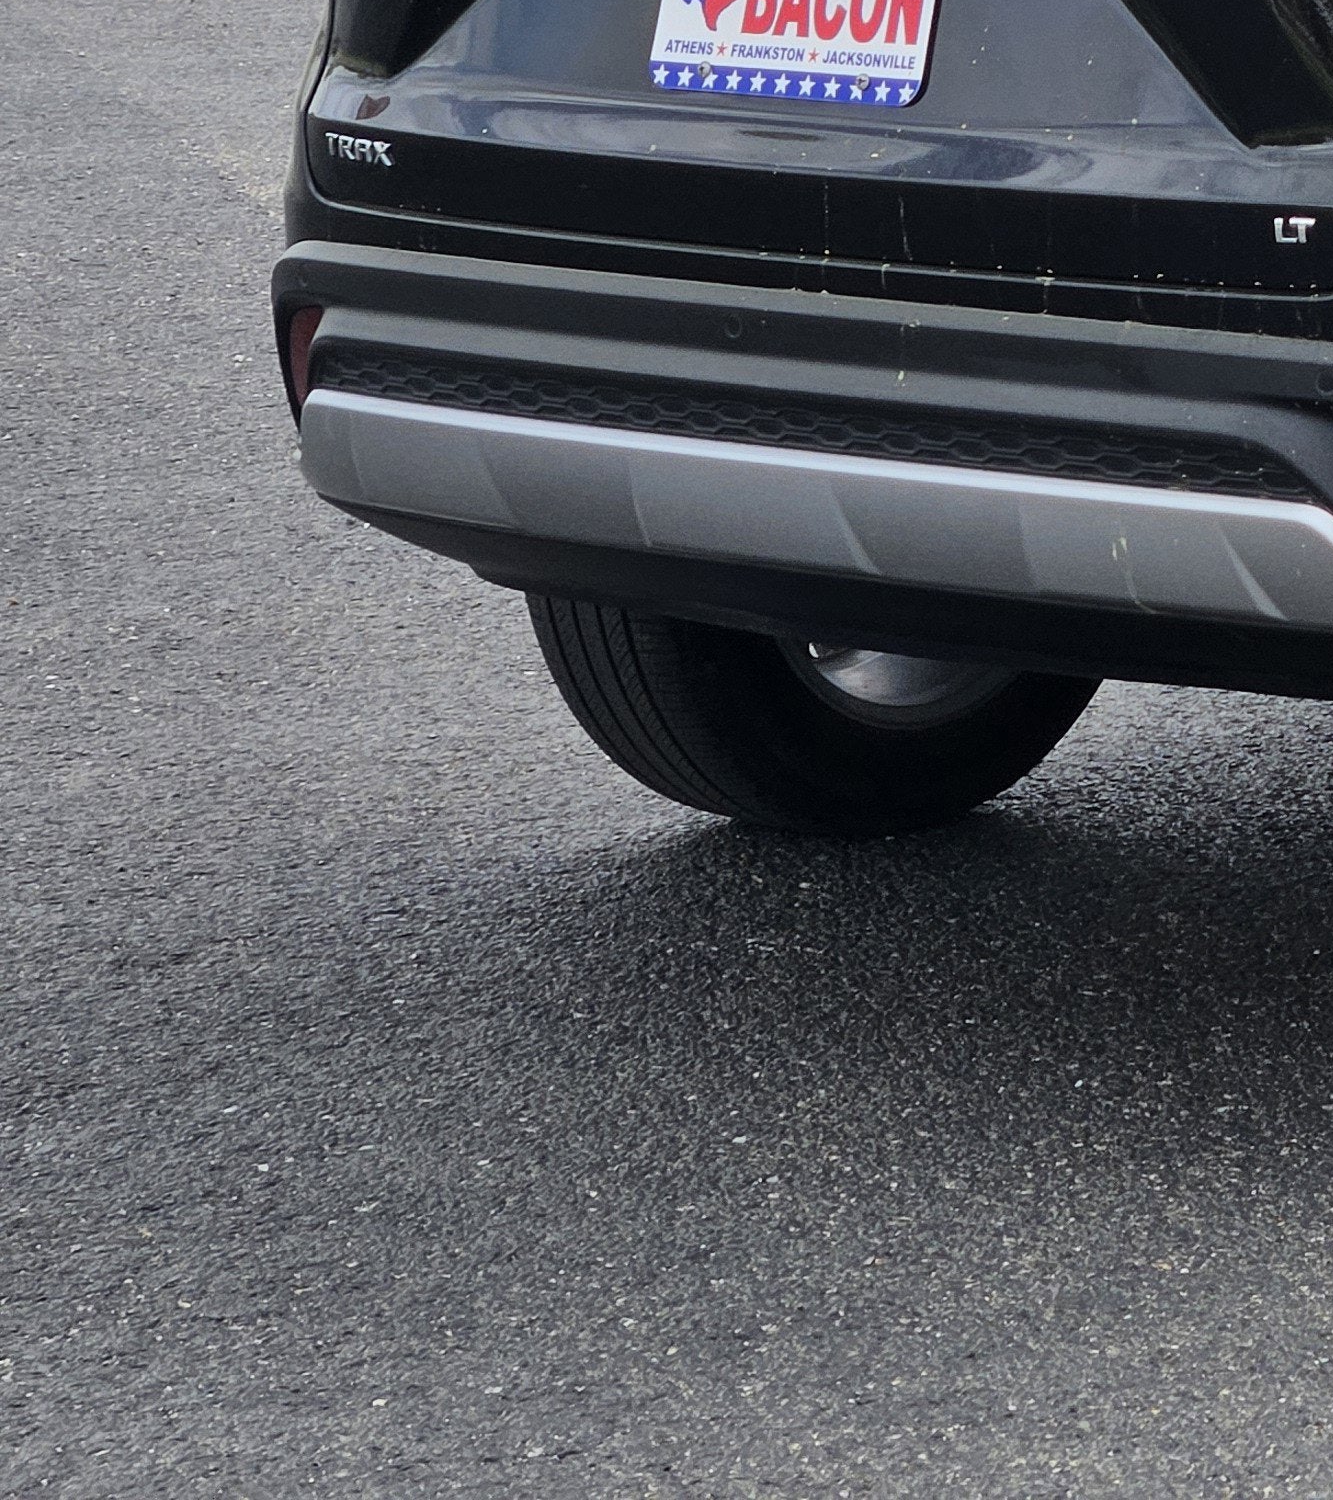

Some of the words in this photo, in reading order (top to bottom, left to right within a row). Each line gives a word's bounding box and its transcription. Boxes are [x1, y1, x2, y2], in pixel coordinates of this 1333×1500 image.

[664, 39, 714, 56] ATHENS
[730, 43, 805, 62] FRANKSTON
[822, 50, 916, 70] JACKSONVILLE
[325, 132, 392, 167] TRAX
[1274, 216, 1316, 243] LT
